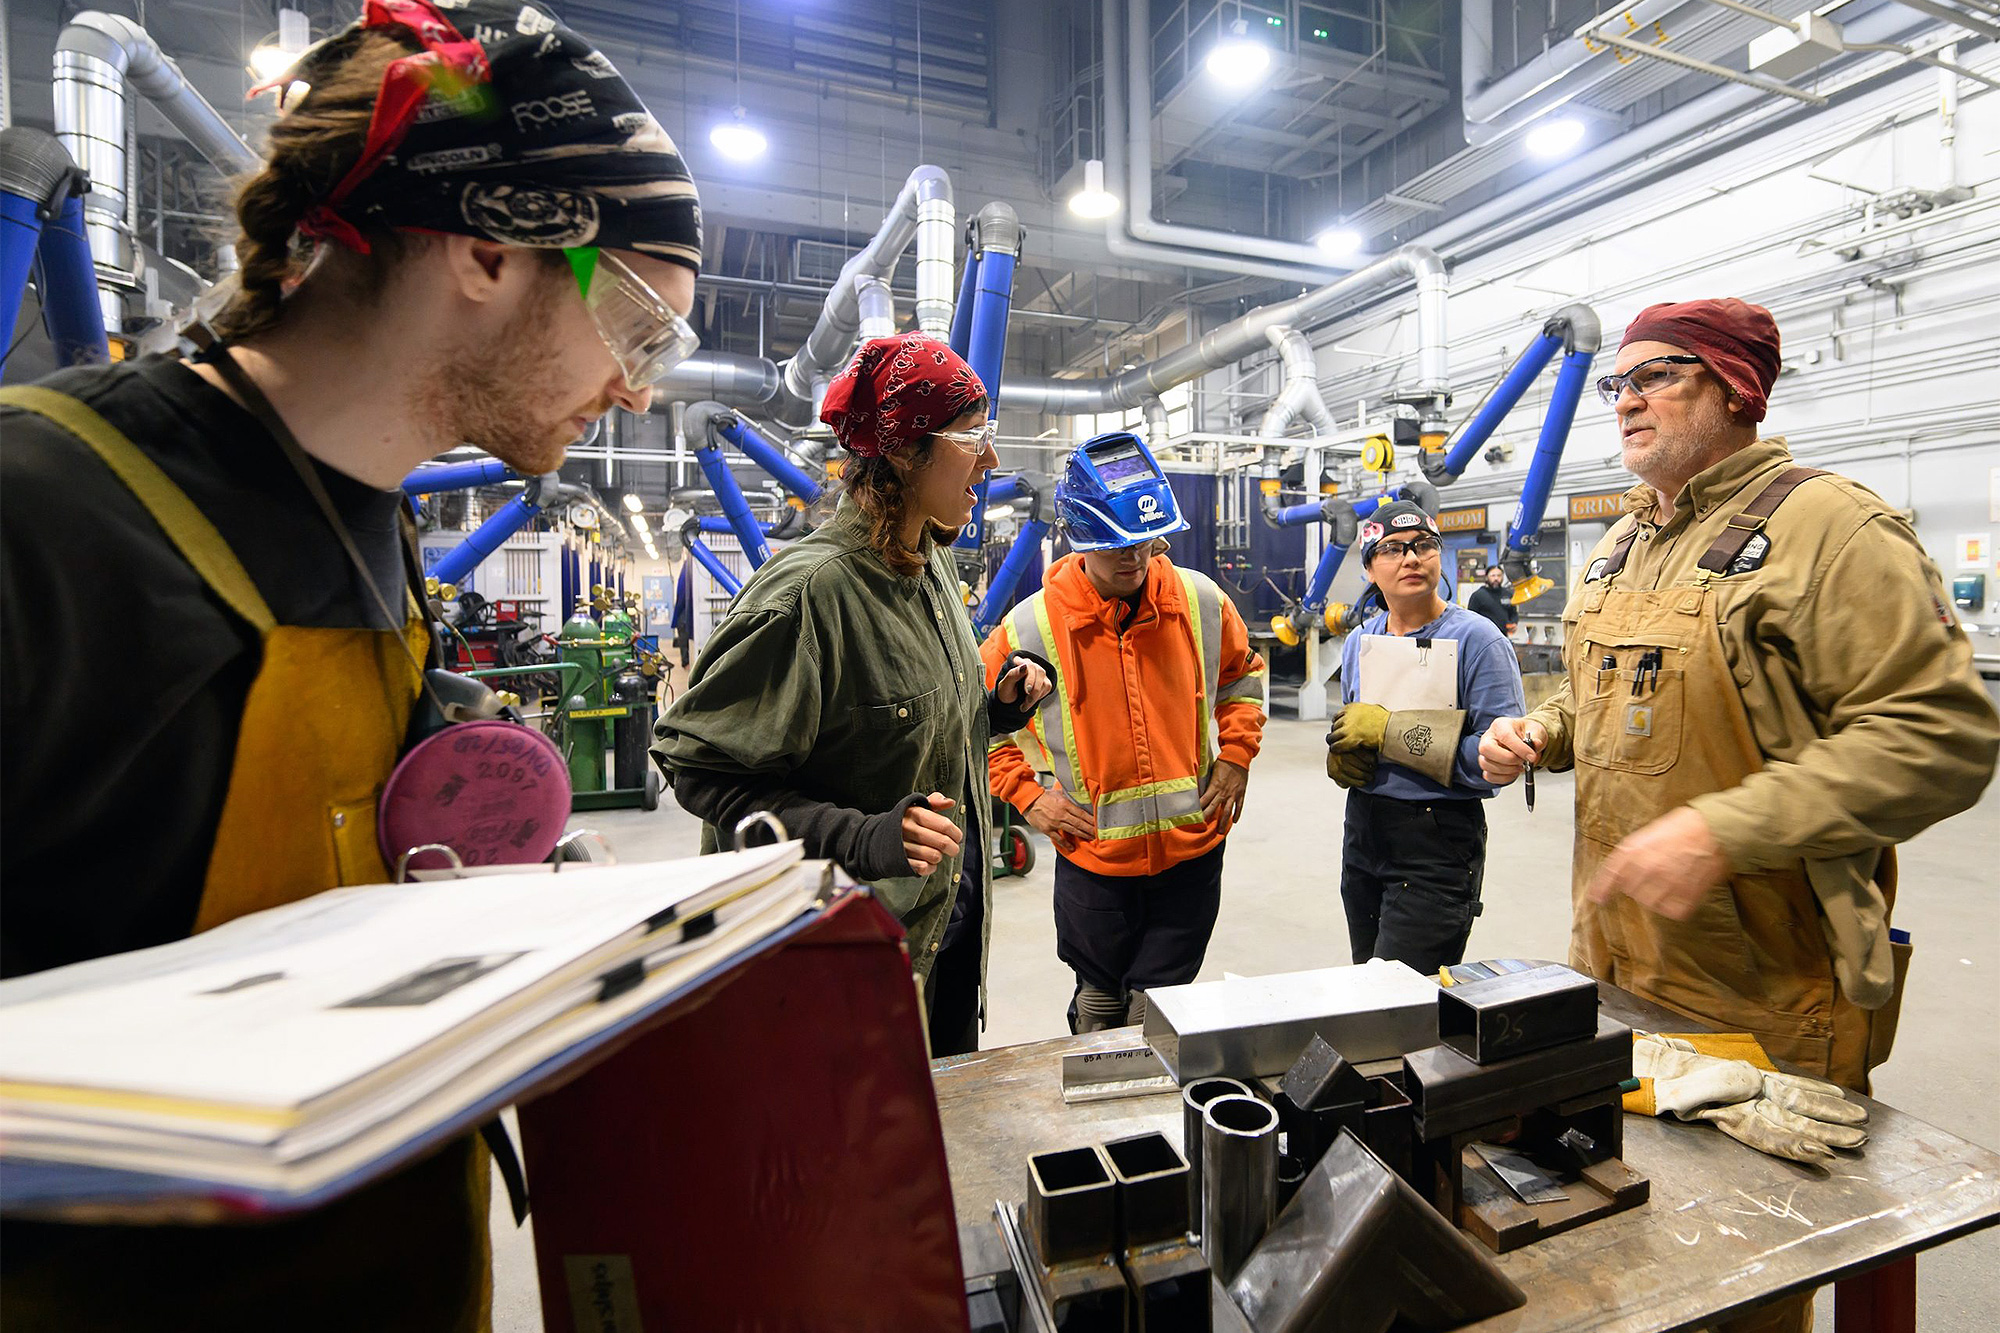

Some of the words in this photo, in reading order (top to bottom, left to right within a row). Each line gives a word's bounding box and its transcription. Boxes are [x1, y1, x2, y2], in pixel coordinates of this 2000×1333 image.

[511, 89, 595, 133] FOOSE
[1573, 494, 1623, 515] GRIN
[1442, 513, 1482, 528] ROOM
[1413, 727, 1427, 753] TRUST
